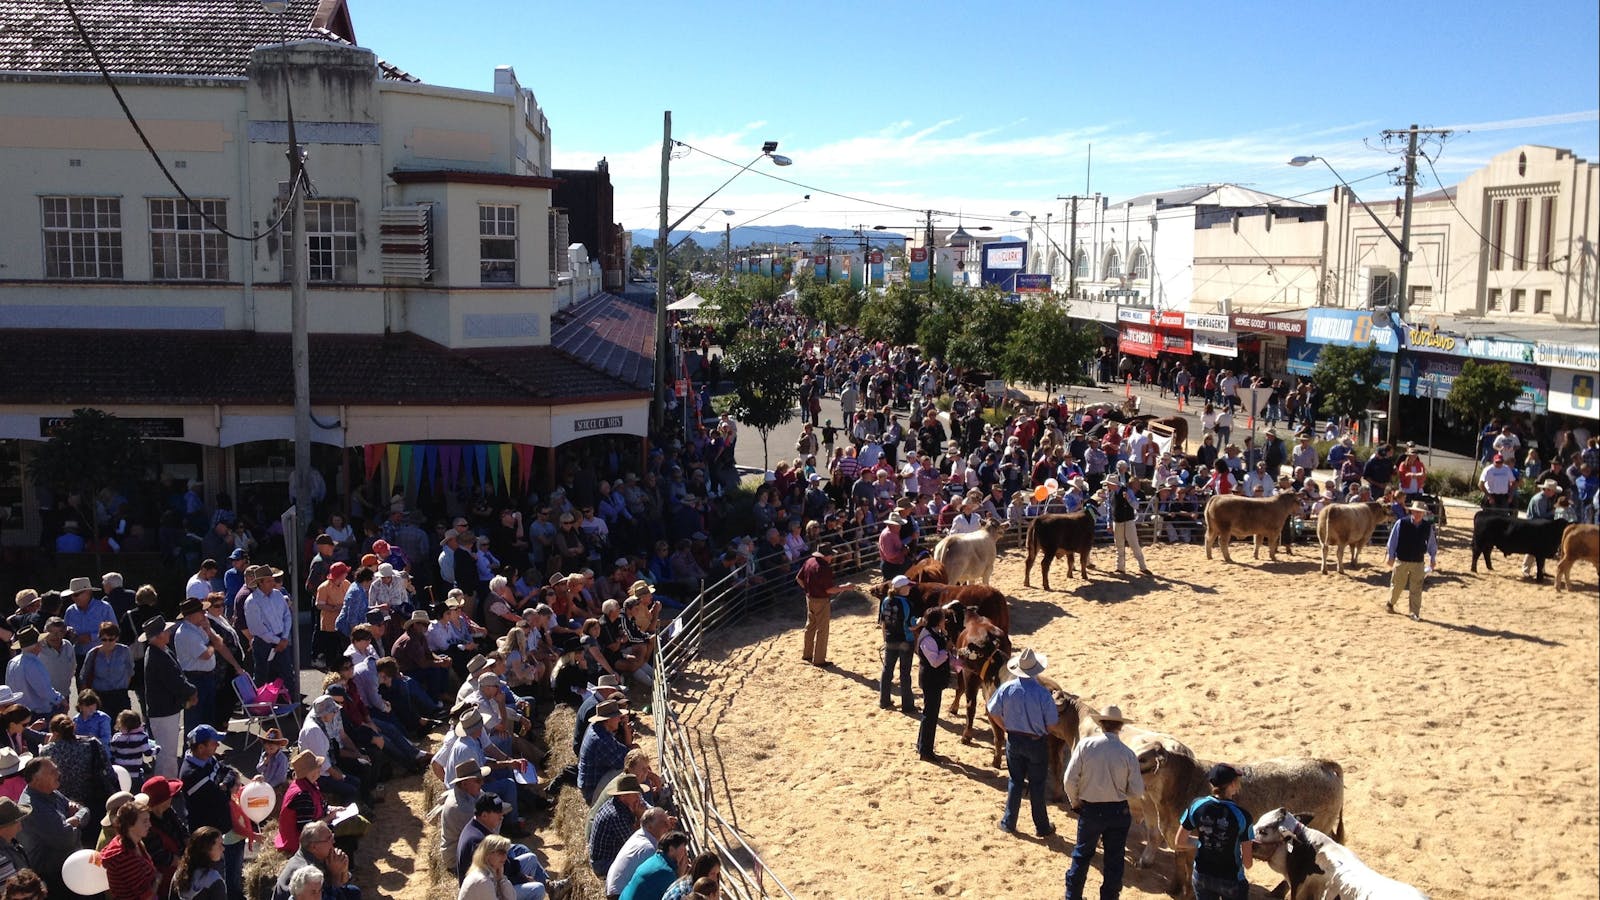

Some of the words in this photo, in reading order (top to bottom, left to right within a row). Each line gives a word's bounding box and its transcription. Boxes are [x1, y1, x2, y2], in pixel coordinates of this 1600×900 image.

[1198, 317, 1227, 329] NEWSAGENCY
[1277, 322, 1301, 332] MENSLAND
[1311, 316, 1353, 340] SUMMERLAND
[1409, 329, 1455, 350] TOYLAND
[1468, 339, 1485, 356] POOL
[1539, 344, 1553, 362] Bill
[1557, 346, 1597, 368] Williams
[577, 420, 597, 430] SCHOOL
[598, 419, 606, 428] OF
[607, 418, 621, 427] ARTS
